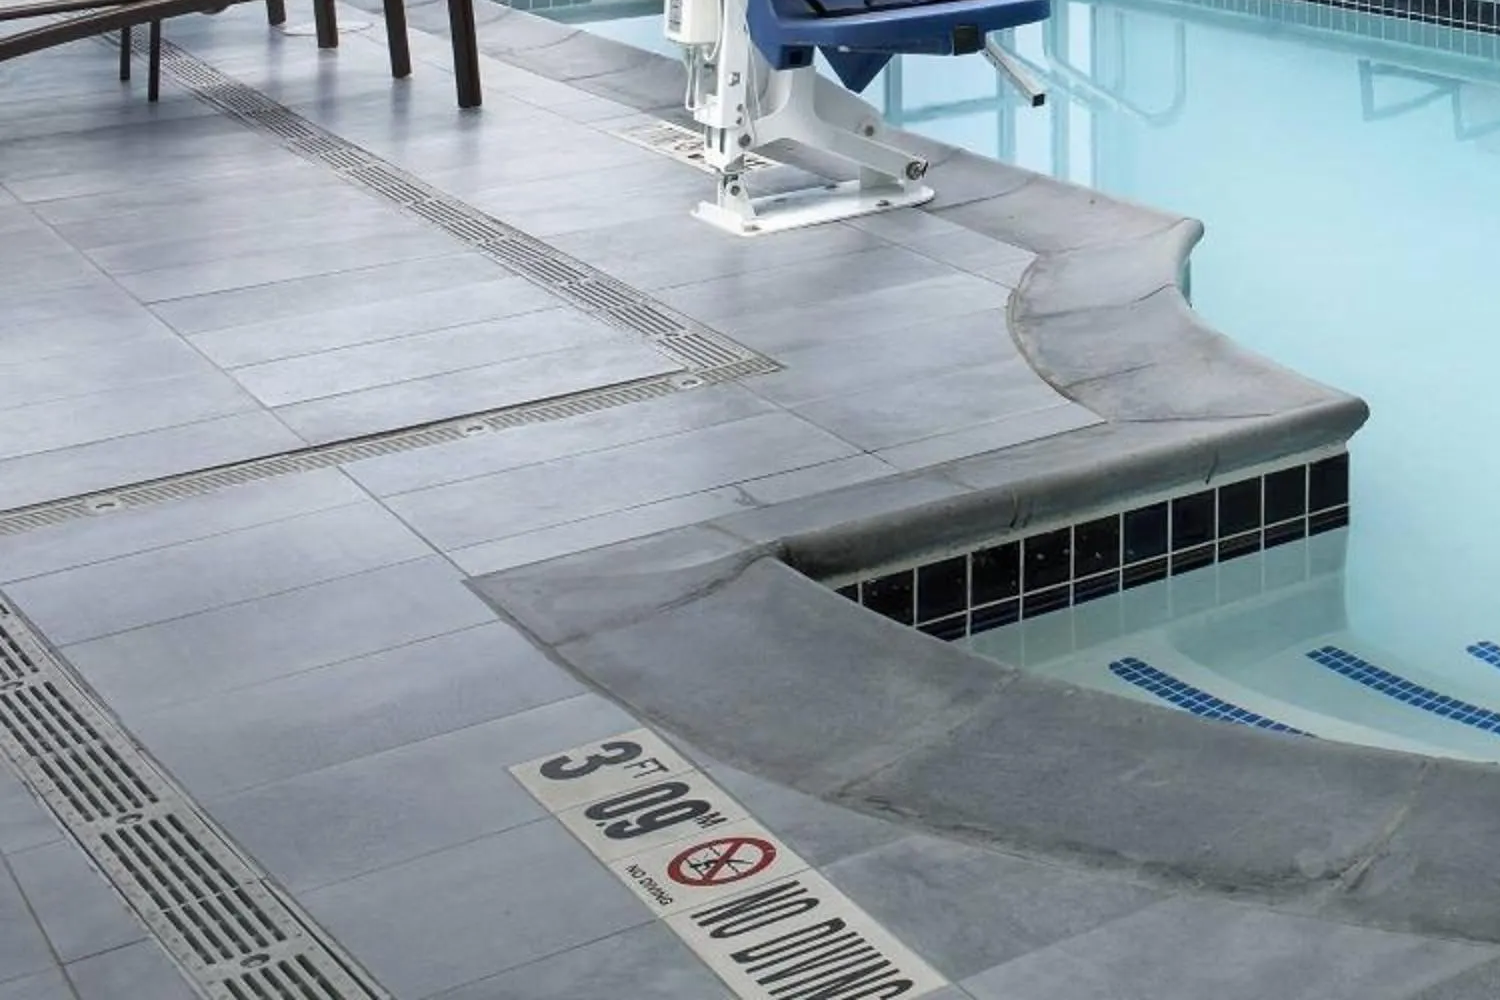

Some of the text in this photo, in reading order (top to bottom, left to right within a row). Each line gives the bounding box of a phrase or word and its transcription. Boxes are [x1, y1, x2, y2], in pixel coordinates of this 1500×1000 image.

[540, 741, 642, 780] 3
[624, 757, 669, 778] FT
[690, 880, 820, 939] NO
